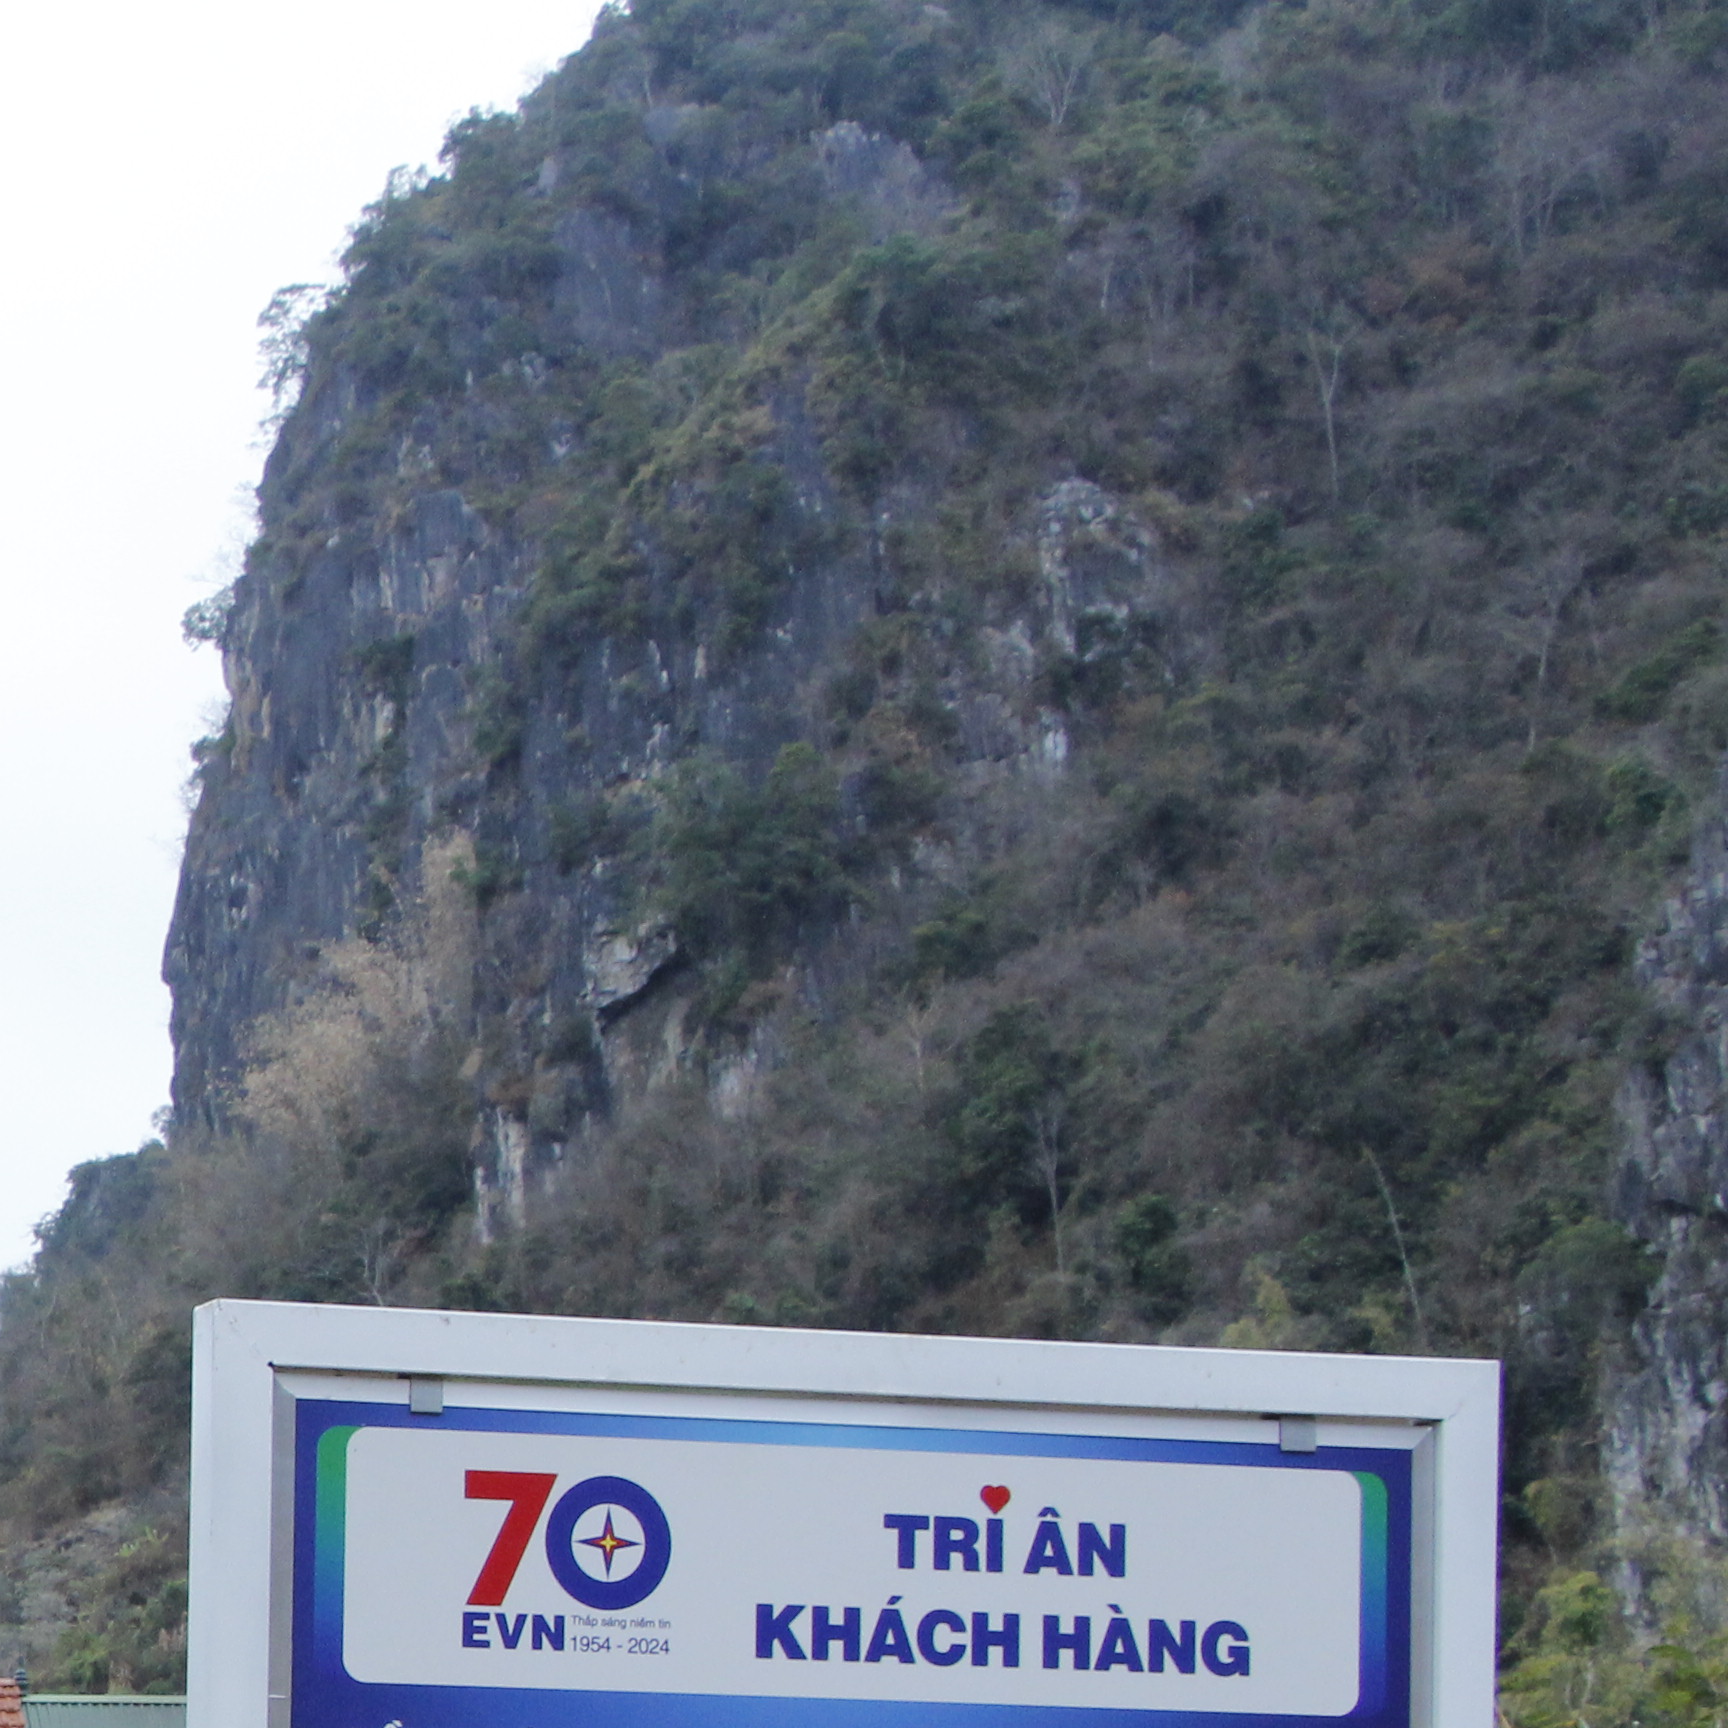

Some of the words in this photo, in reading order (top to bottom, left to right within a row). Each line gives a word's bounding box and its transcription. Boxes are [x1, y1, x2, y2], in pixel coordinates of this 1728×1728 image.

[464, 1469, 672, 1611] 70
[1023, 1507, 1127, 1578] ÂN
[462, 1611, 565, 1651] EVN
[570, 1636, 611, 1652] 1954
[627, 1638, 670, 1654] 2024
[600, 1616, 626, 1629] sáng
[657, 1617, 671, 1629] tin
[755, 1596, 1020, 1668] KHÁCH
[1042, 1604, 1251, 1677] HÀNG
